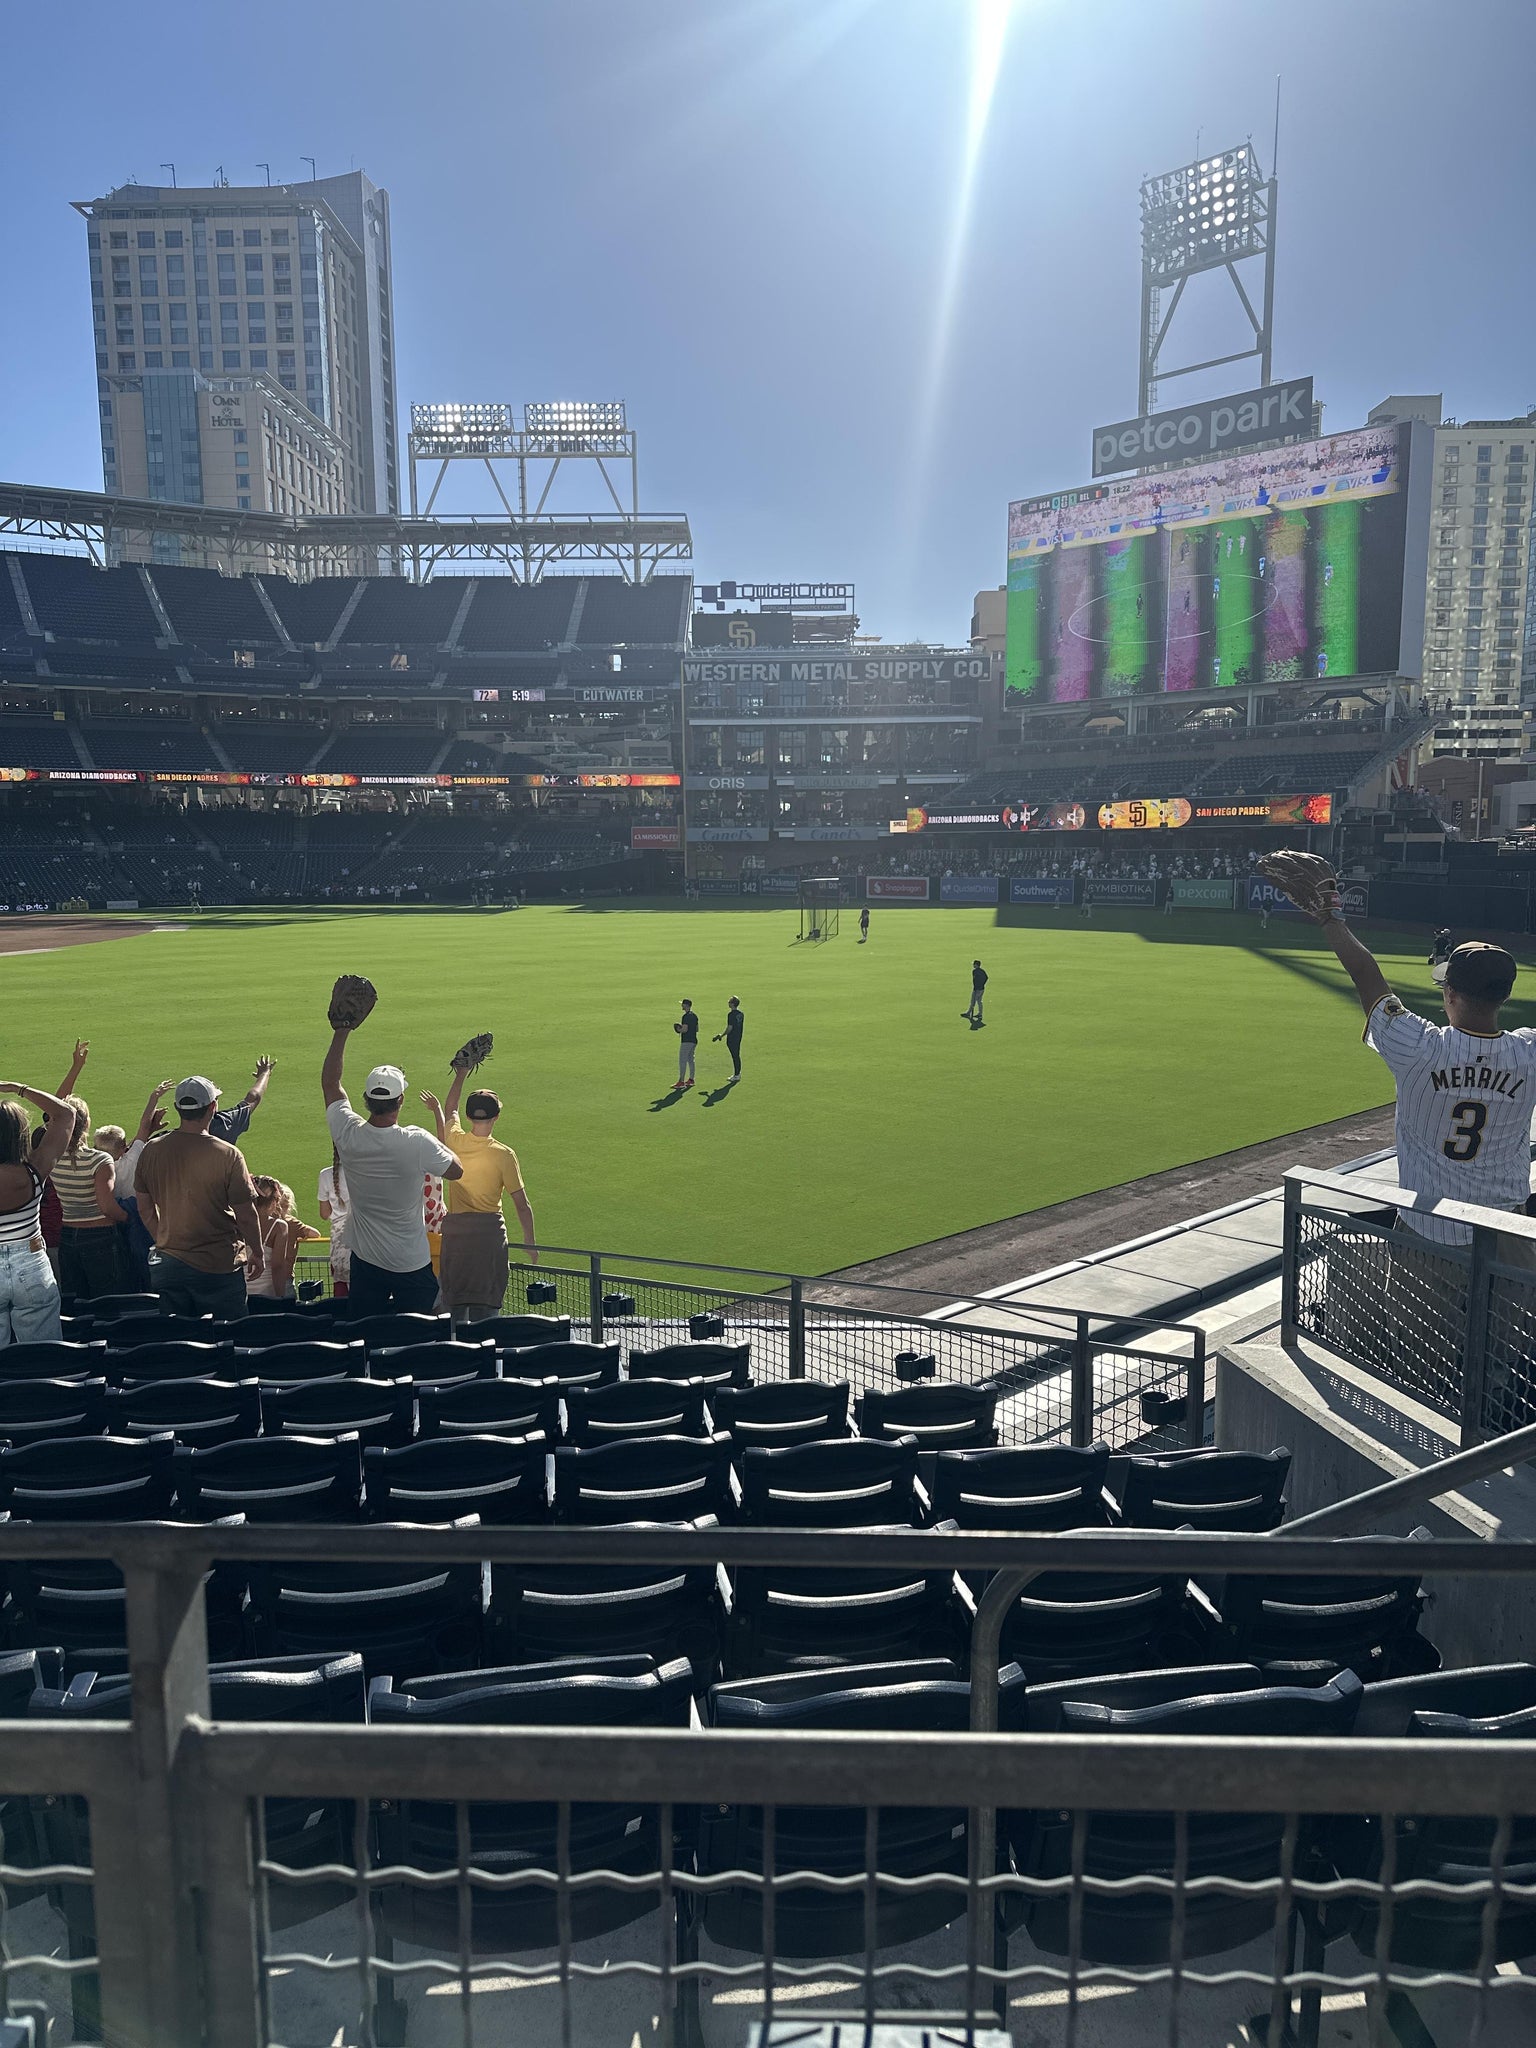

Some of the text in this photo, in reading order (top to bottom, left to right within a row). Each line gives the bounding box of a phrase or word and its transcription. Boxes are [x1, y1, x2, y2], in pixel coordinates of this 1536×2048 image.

[1094, 388, 1307, 474] petco park
[1348, 475, 1374, 489] VISA
[1039, 501, 1051, 510] USA
[1112, 485, 1131, 494] 18:22
[1288, 487, 1313, 500] VISA
[1233, 497, 1257, 511] VISA
[1091, 526, 1111, 537] VISA
[741, 582, 847, 602] QuidelOrtho
[684, 659, 989, 683] WESTERN METAL SUPPLY CO.
[512, 690, 530, 701] 5:19
[583, 690, 644, 701] CUTWATER
[50, 771, 137, 780] ARIZONA DIAMONDBACKS
[156, 773, 171, 781] SAN
[192, 774, 219, 782] PADRES
[361, 776, 388, 784] ARIZONA
[388, 776, 437, 784] DIAMONDBACKS
[709, 777, 745, 789] ORIS
[1196, 806, 1271, 817] SAN DIEGO PADRES
[928, 814, 1000, 824] ARIZONA DIAMONDBACKS
[702, 829, 753, 841] Canel's
[696, 842, 714, 852] 336
[742, 882, 757, 892] 342
[885, 884, 922, 893] Snapdragon
[1430, 1066, 1524, 1099] MERRILL
[1443, 1100, 1488, 1162] 3
